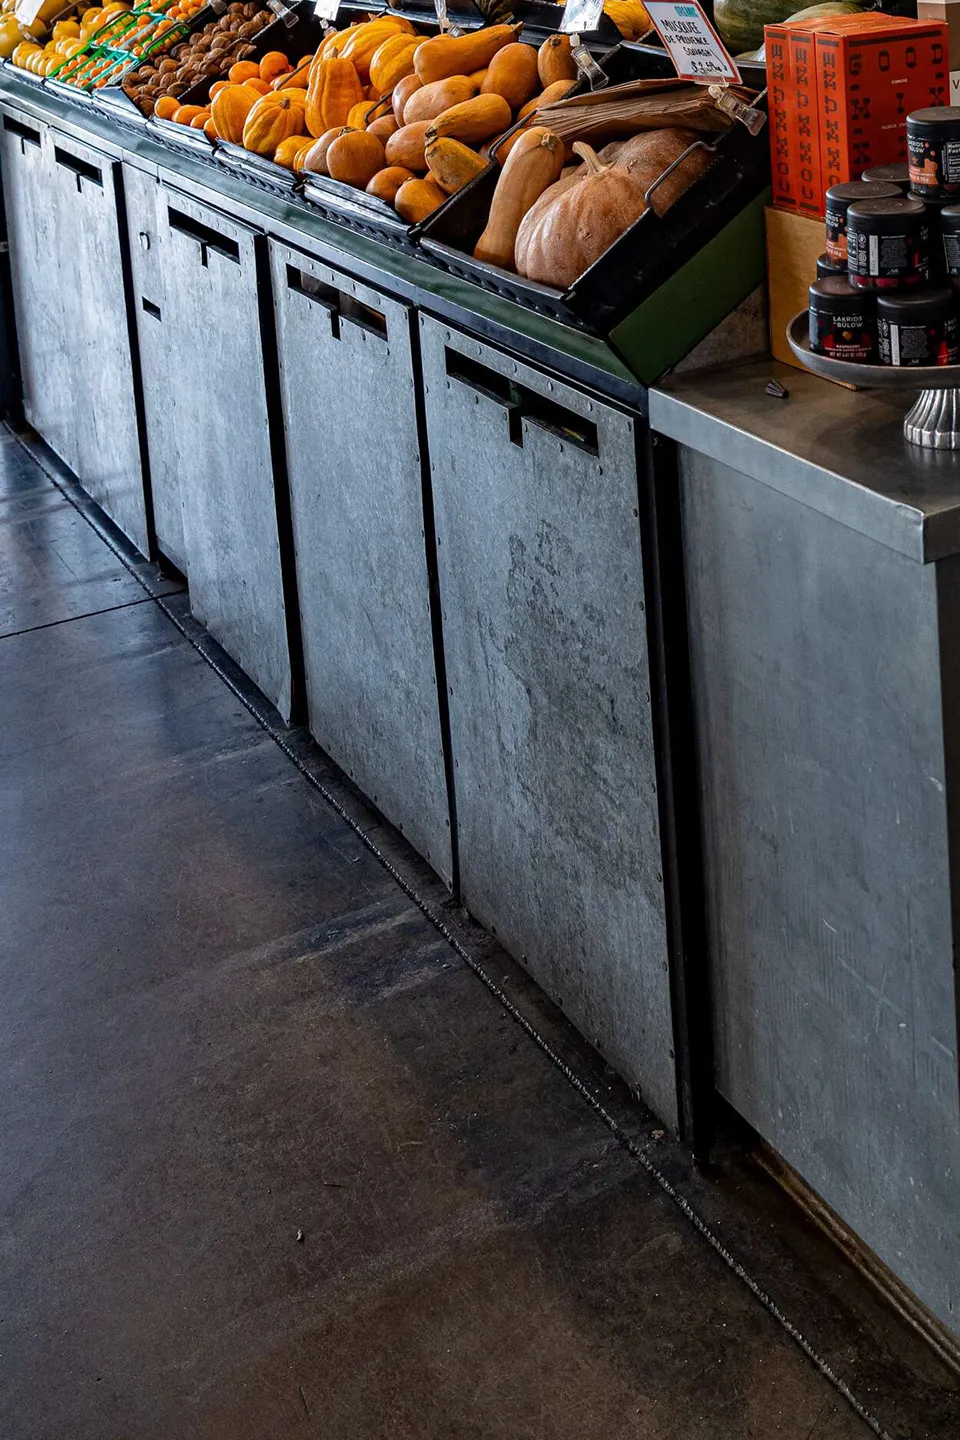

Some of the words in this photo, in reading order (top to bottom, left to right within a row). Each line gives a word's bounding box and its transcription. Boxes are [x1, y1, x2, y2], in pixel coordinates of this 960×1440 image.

[666, 35, 676, 44] DE
[684, 47, 712, 57] SQUASH
[771, 44, 790, 193] COMMUNE
[796, 47, 814, 199] COMMUNE
